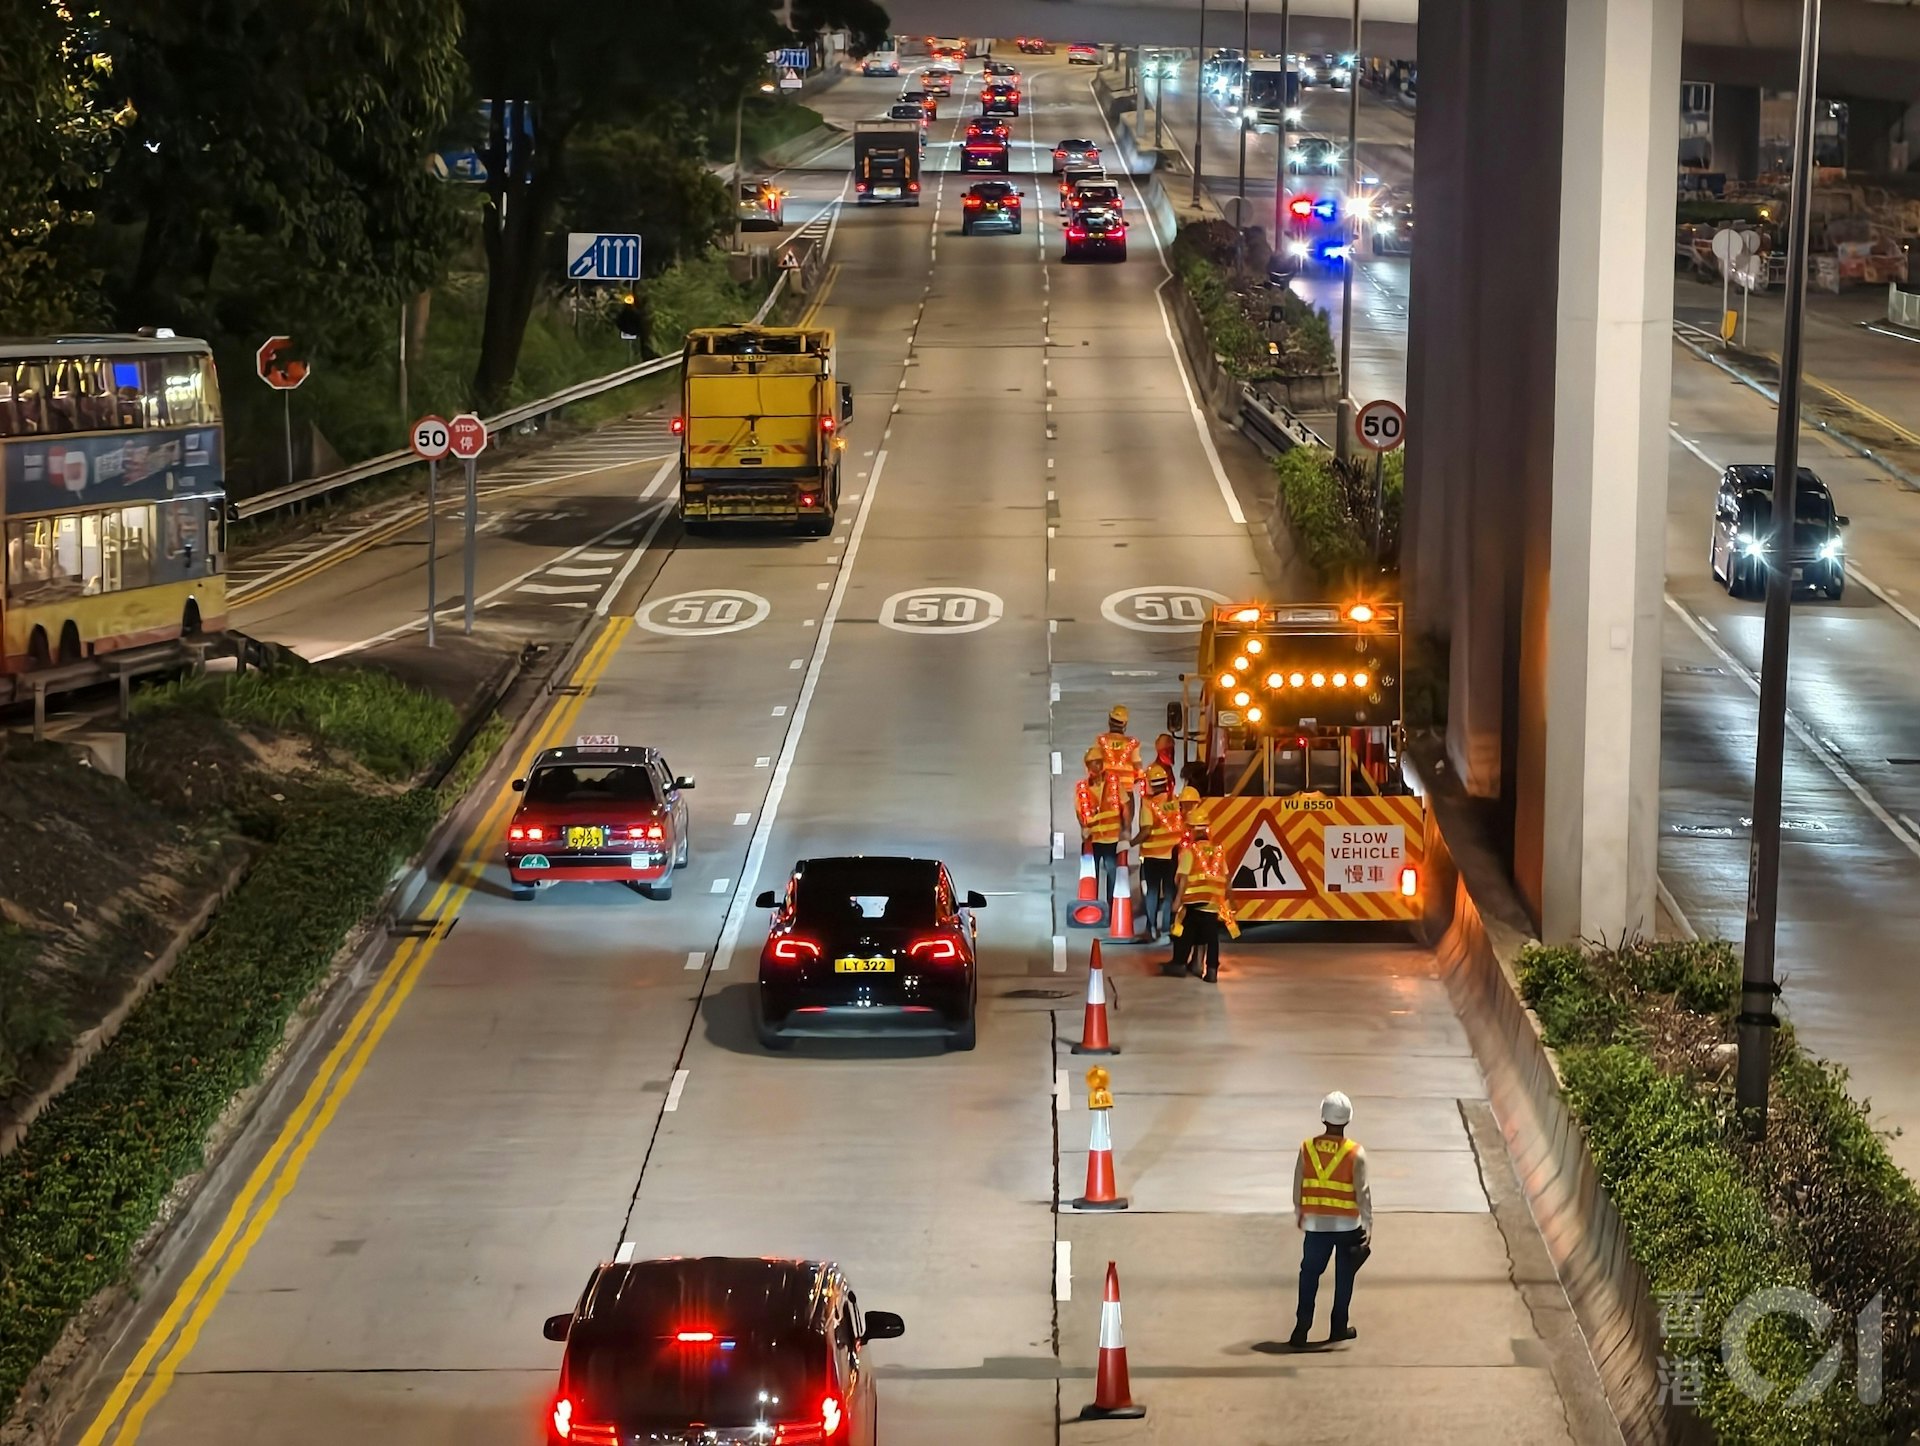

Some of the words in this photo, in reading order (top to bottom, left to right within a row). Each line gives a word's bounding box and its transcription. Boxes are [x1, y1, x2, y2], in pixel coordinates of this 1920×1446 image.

[454, 424, 478, 433] STOP
[1364, 415, 1400, 437] 50
[418, 430, 446, 447] 50
[667, 599, 743, 624] 50
[906, 598, 977, 622] 50
[1134, 596, 1206, 621] 50
[580, 735, 616, 745] TAXI
[1284, 800, 1299, 810] VU
[1303, 800, 1334, 810] 8550
[579, 828, 592, 839] JX
[1342, 832, 1388, 844] SLOW
[571, 837, 600, 848] 9723
[1331, 847, 1400, 859] VEHICLE
[1344, 864, 1385, 884] 慢車
[843, 961, 859, 970] LY
[863, 961, 886, 971] 322
